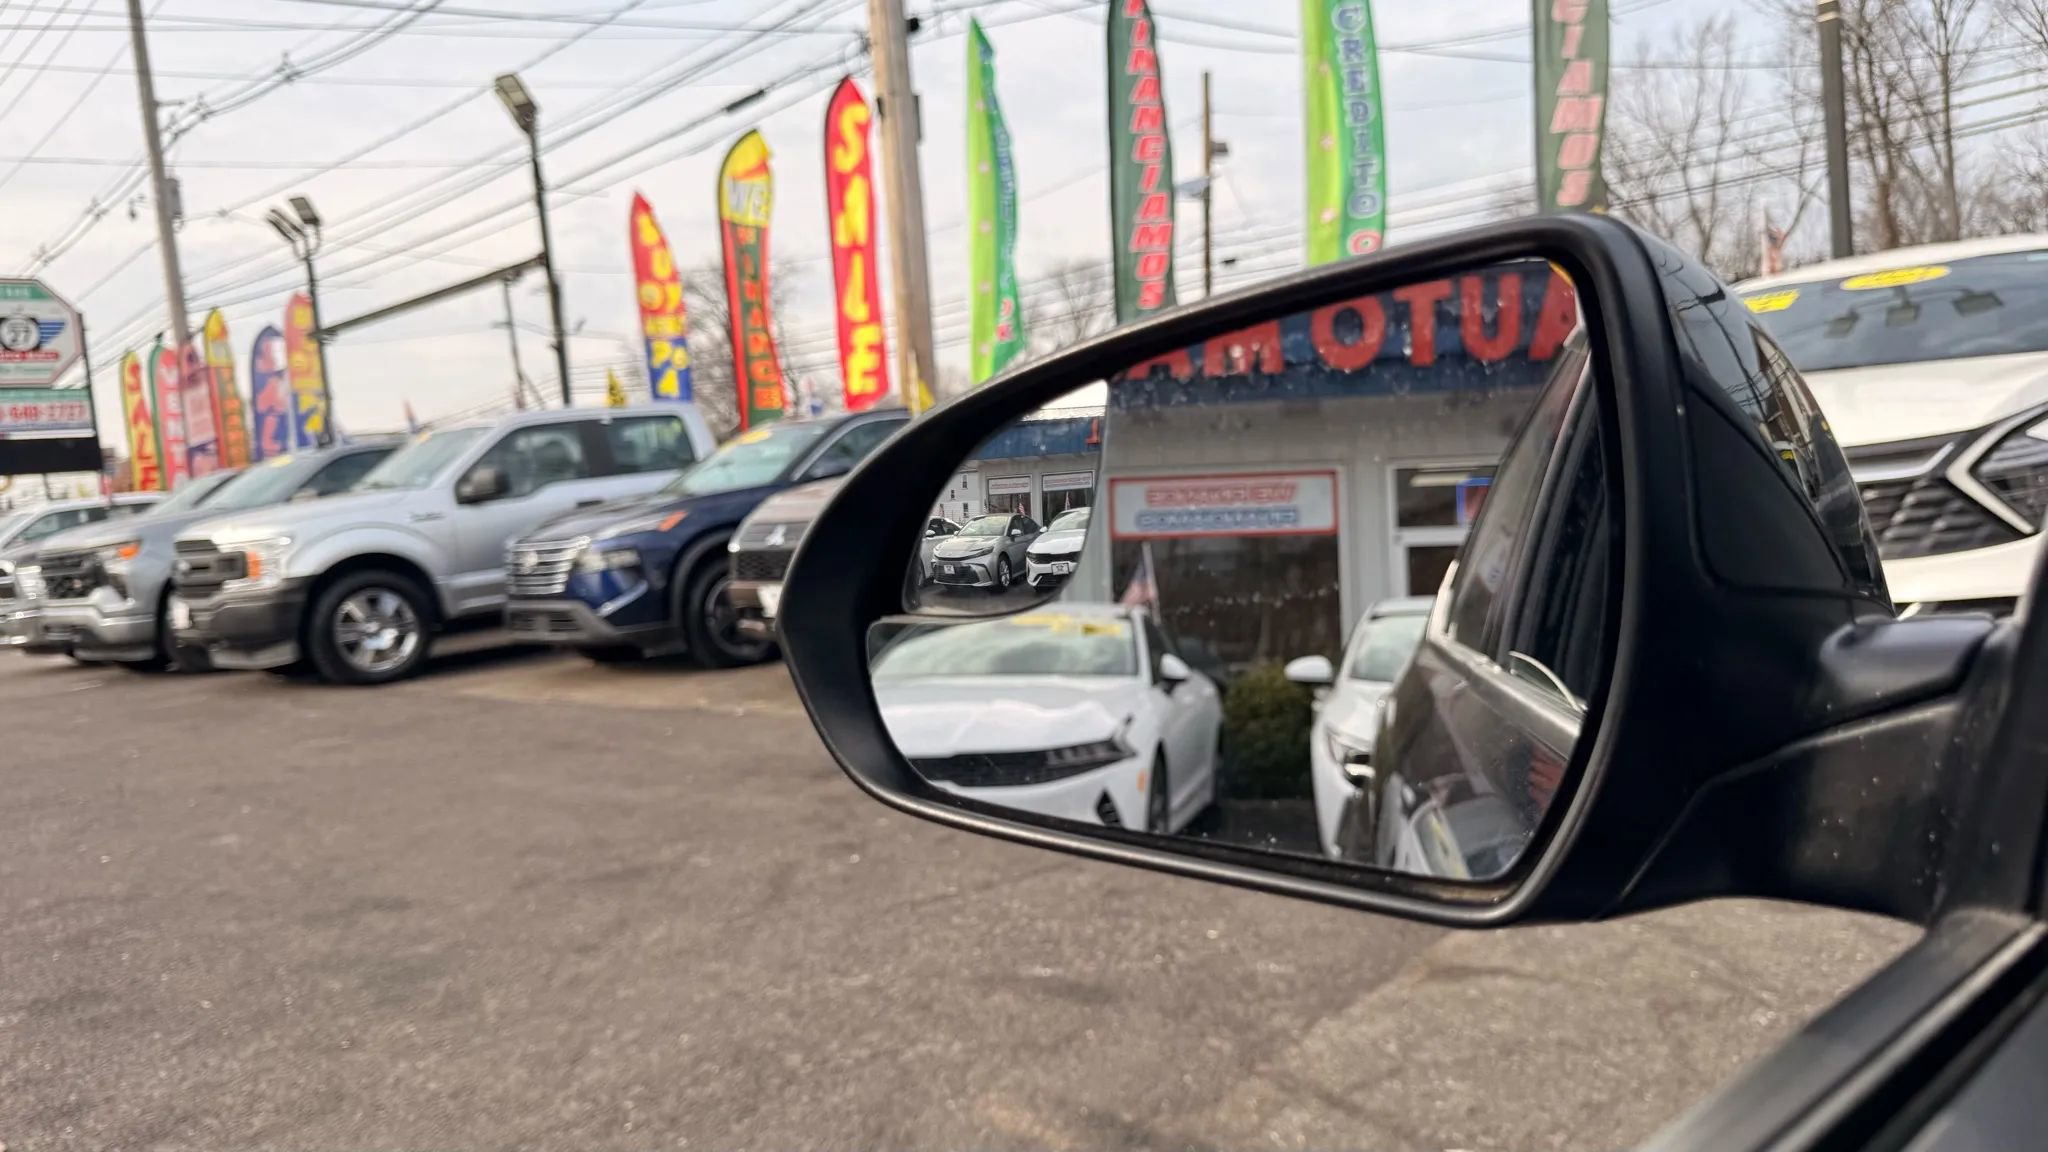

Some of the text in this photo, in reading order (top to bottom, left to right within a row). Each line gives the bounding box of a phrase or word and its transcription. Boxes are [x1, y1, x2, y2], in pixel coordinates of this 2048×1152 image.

[1331, 3, 1383, 219] CREDITO
[833, 104, 883, 394] SALE
[127, 362, 159, 491] SALE
